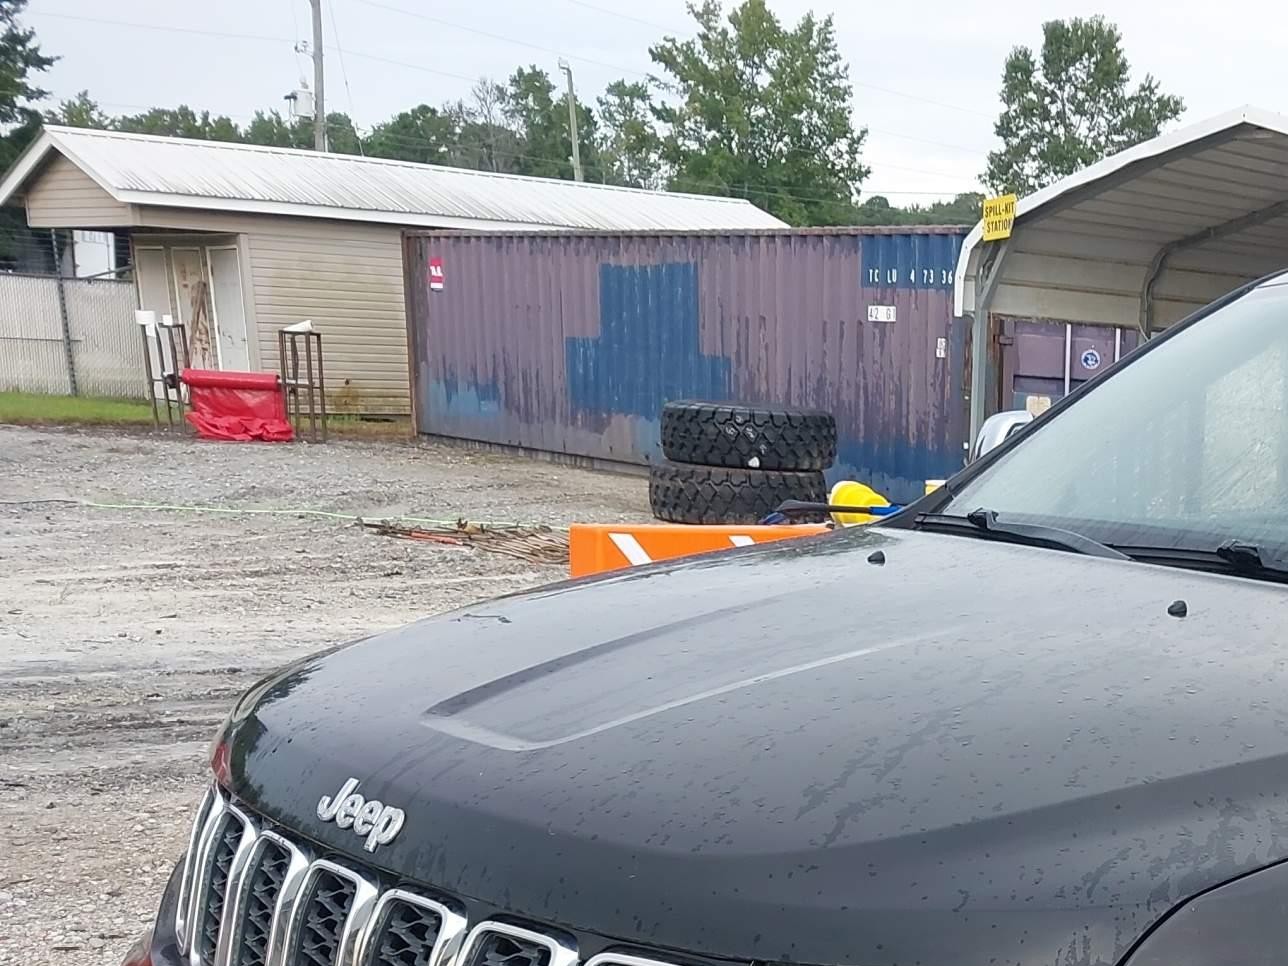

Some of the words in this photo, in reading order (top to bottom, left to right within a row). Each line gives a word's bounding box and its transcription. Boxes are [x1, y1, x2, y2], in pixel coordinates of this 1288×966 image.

[985, 202, 1015, 218] SPILL-KIT
[986, 219, 1012, 233] STATION
[316, 777, 405, 853] Jeep
